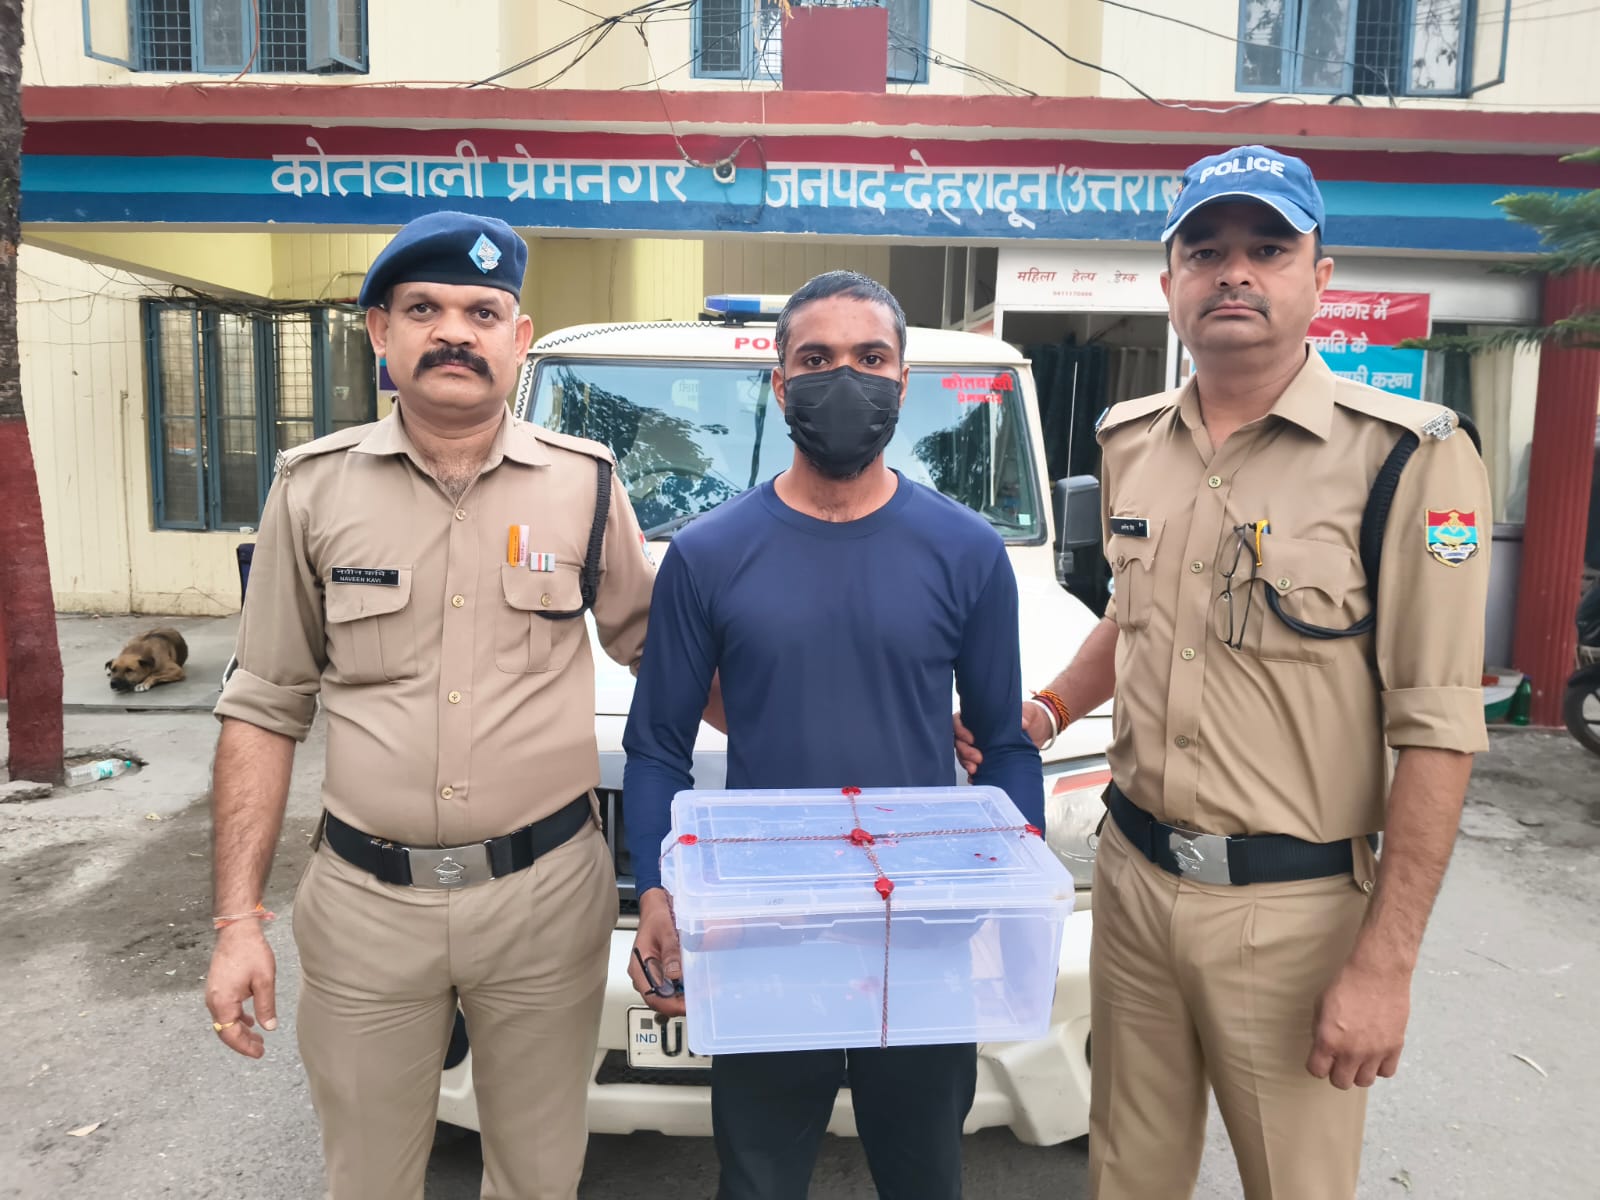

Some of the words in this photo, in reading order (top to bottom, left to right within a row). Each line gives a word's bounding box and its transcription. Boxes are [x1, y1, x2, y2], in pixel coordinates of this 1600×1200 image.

[271, 136, 490, 198] कोतवाली
[497, 143, 699, 204] प्रेमनगर
[1200, 156, 1286, 184] POLICE
[1017, 267, 1057, 283] महिला
[1072, 269, 1097, 283] हेल्प
[1317, 302, 1370, 320] मनगर
[1373, 298, 1391, 320] में
[1350, 331, 1368, 353] के
[1371, 372, 1413, 388] करना
[636, 1033, 658, 1043] IND
